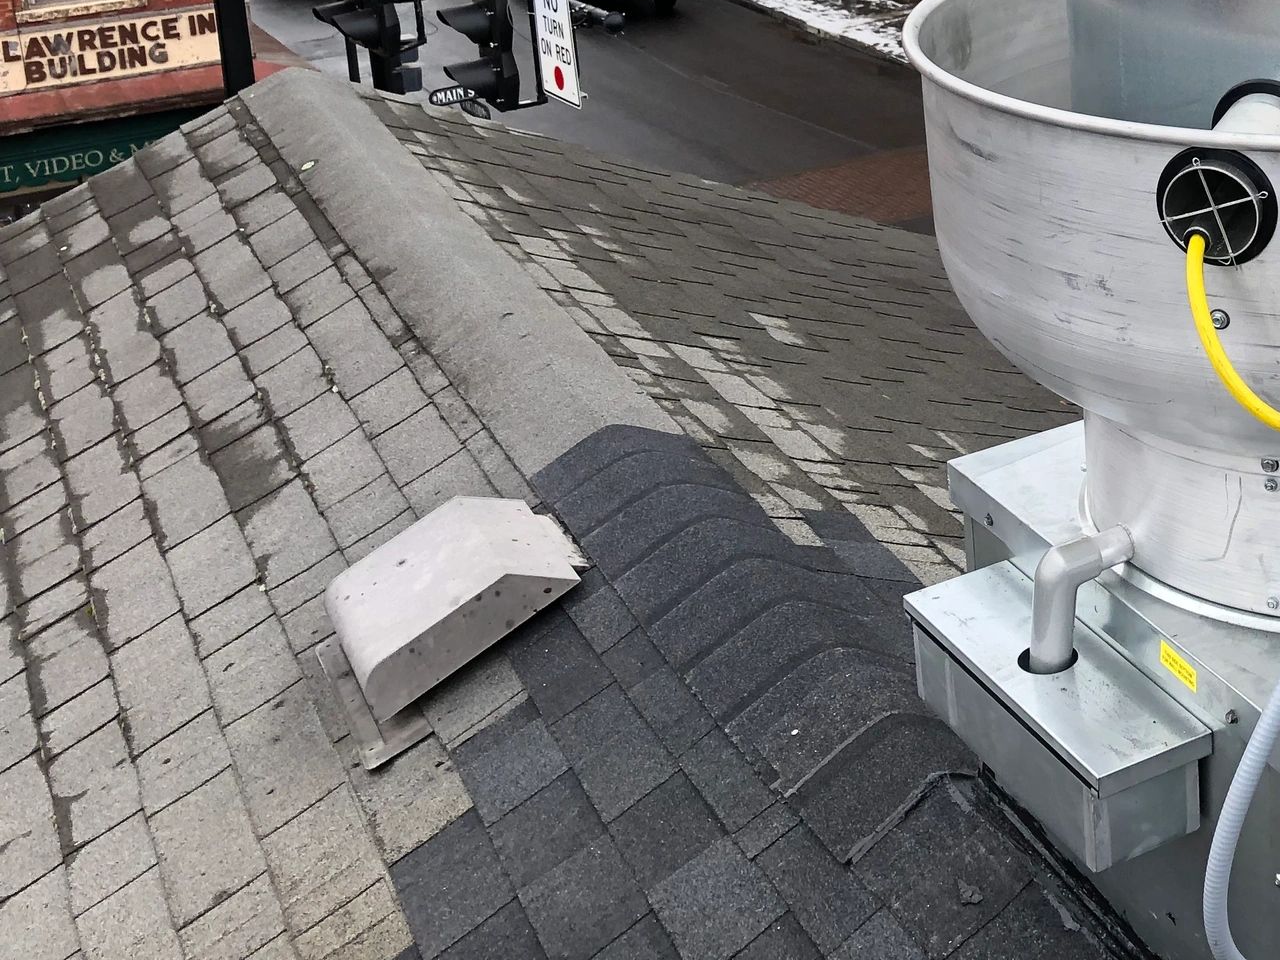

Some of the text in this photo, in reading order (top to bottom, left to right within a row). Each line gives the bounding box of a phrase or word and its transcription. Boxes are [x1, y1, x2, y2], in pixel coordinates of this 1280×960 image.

[2, 16, 180, 64] LAWRENCE
[543, 15, 564, 40] TURN
[25, 42, 168, 84] BUILDING
[541, 38, 572, 66] ON RED
[436, 88, 464, 104] MAIN
[24, 150, 104, 178] VIDEO
